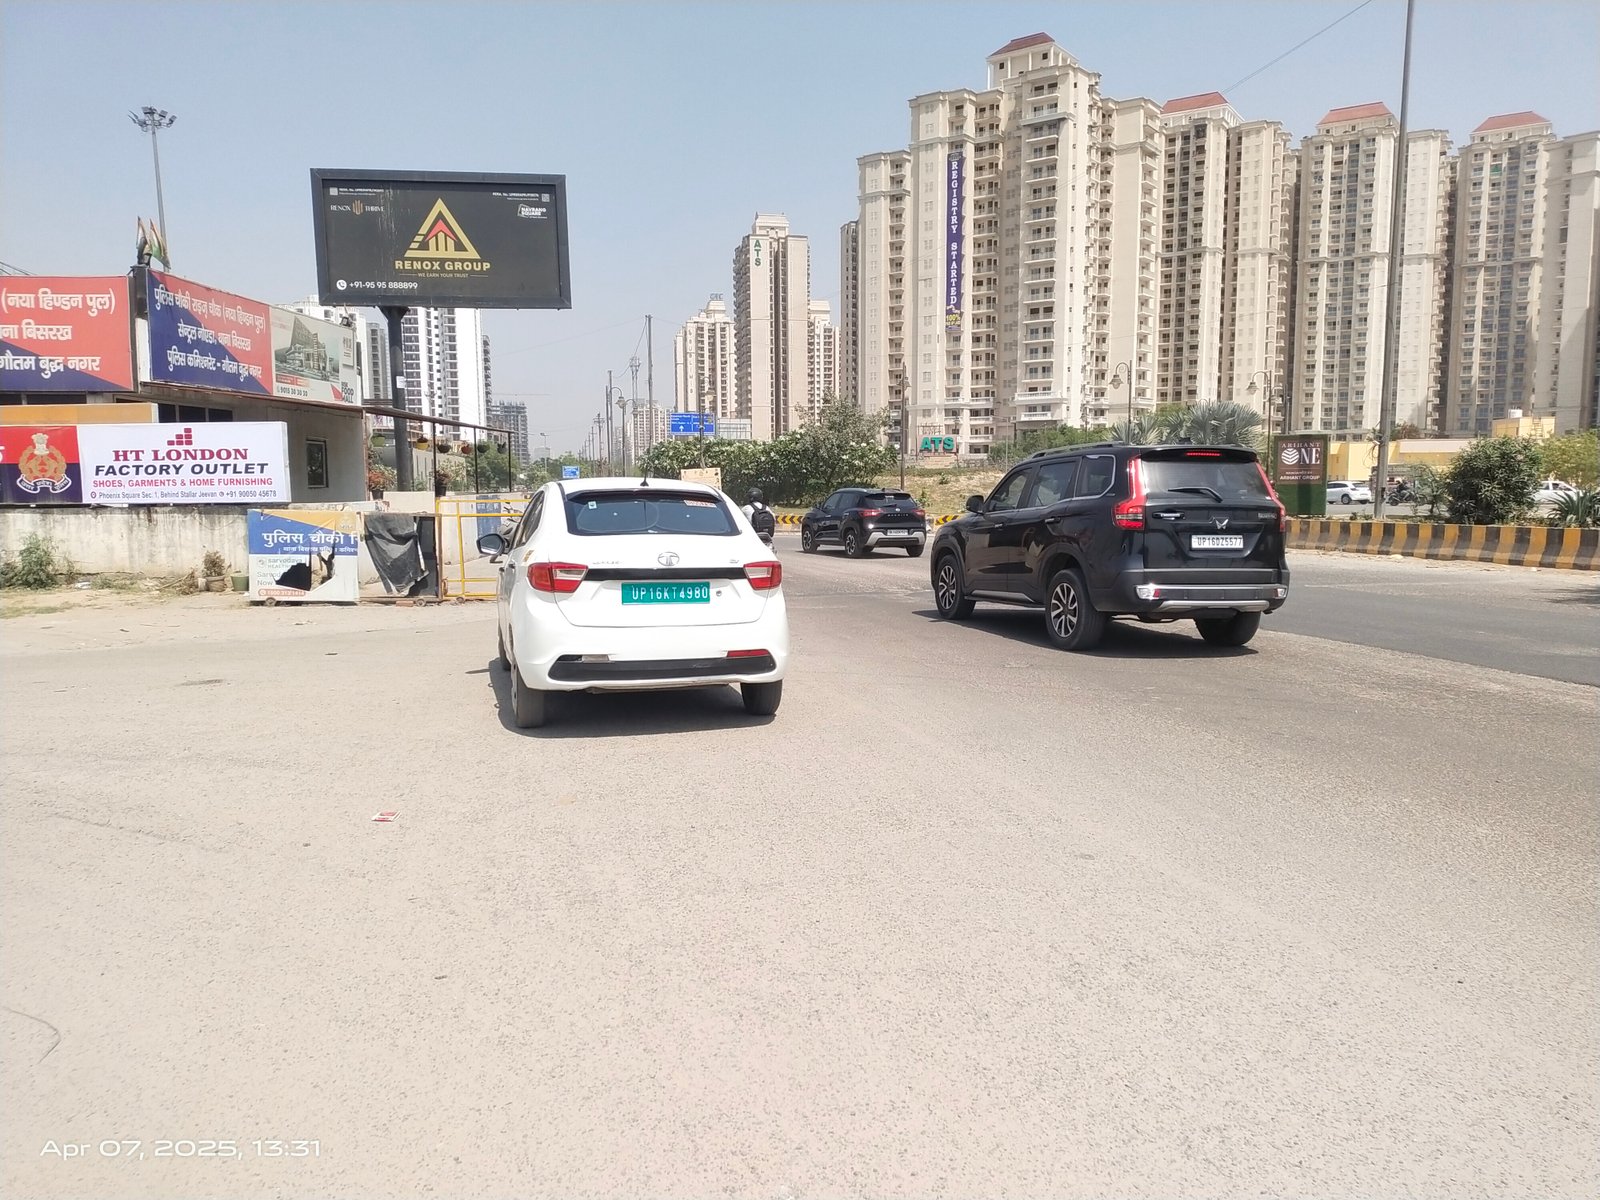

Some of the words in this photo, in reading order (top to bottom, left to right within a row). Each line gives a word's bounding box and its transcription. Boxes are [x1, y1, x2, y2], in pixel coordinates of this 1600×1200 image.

[950, 161, 958, 234] REGISTRY
[330, 204, 351, 212] RENOX
[753, 239, 762, 267] ATS
[394, 260, 441, 270] RENOX
[444, 261, 491, 271] GROUP
[950, 242, 958, 304] STARTED
[349, 281, 376, 289] +91-95
[376, 281, 387, 289] 95
[388, 281, 418, 289] 888899
[1, 288, 35, 314] (नया
[38, 287, 83, 310] हिण्डन
[86, 288, 116, 316] पुल)
[154, 284, 174, 310] पुलिस
[174, 289, 191, 310] चौकी
[209, 298, 222, 318] चौक
[21, 319, 72, 340] बिसरख
[39, 356, 65, 379] बुद्ध
[67, 356, 101, 371] नगर
[167, 345, 186, 372] पुलिस
[221, 355, 238, 375] गौतम
[280, 386, 290, 394] 9015
[920, 436, 955, 452] ATS
[112, 449, 145, 462] HT
[151, 448, 248, 461] LONDON
[95, 464, 184, 476] FACTORY
[190, 463, 269, 475] OUTLET
[93, 480, 126, 489] SHOES,
[128, 479, 177, 487] GARMENTS
[189, 478, 215, 486] HOME
[218, 478, 273, 486] FURNISHING
[99, 491, 121, 499] Phoenix
[122, 491, 140, 500] Square
[261, 529, 304, 548] पुलिस
[308, 530, 345, 544] चौकी
[632, 585, 708, 600] UP16KT4980
